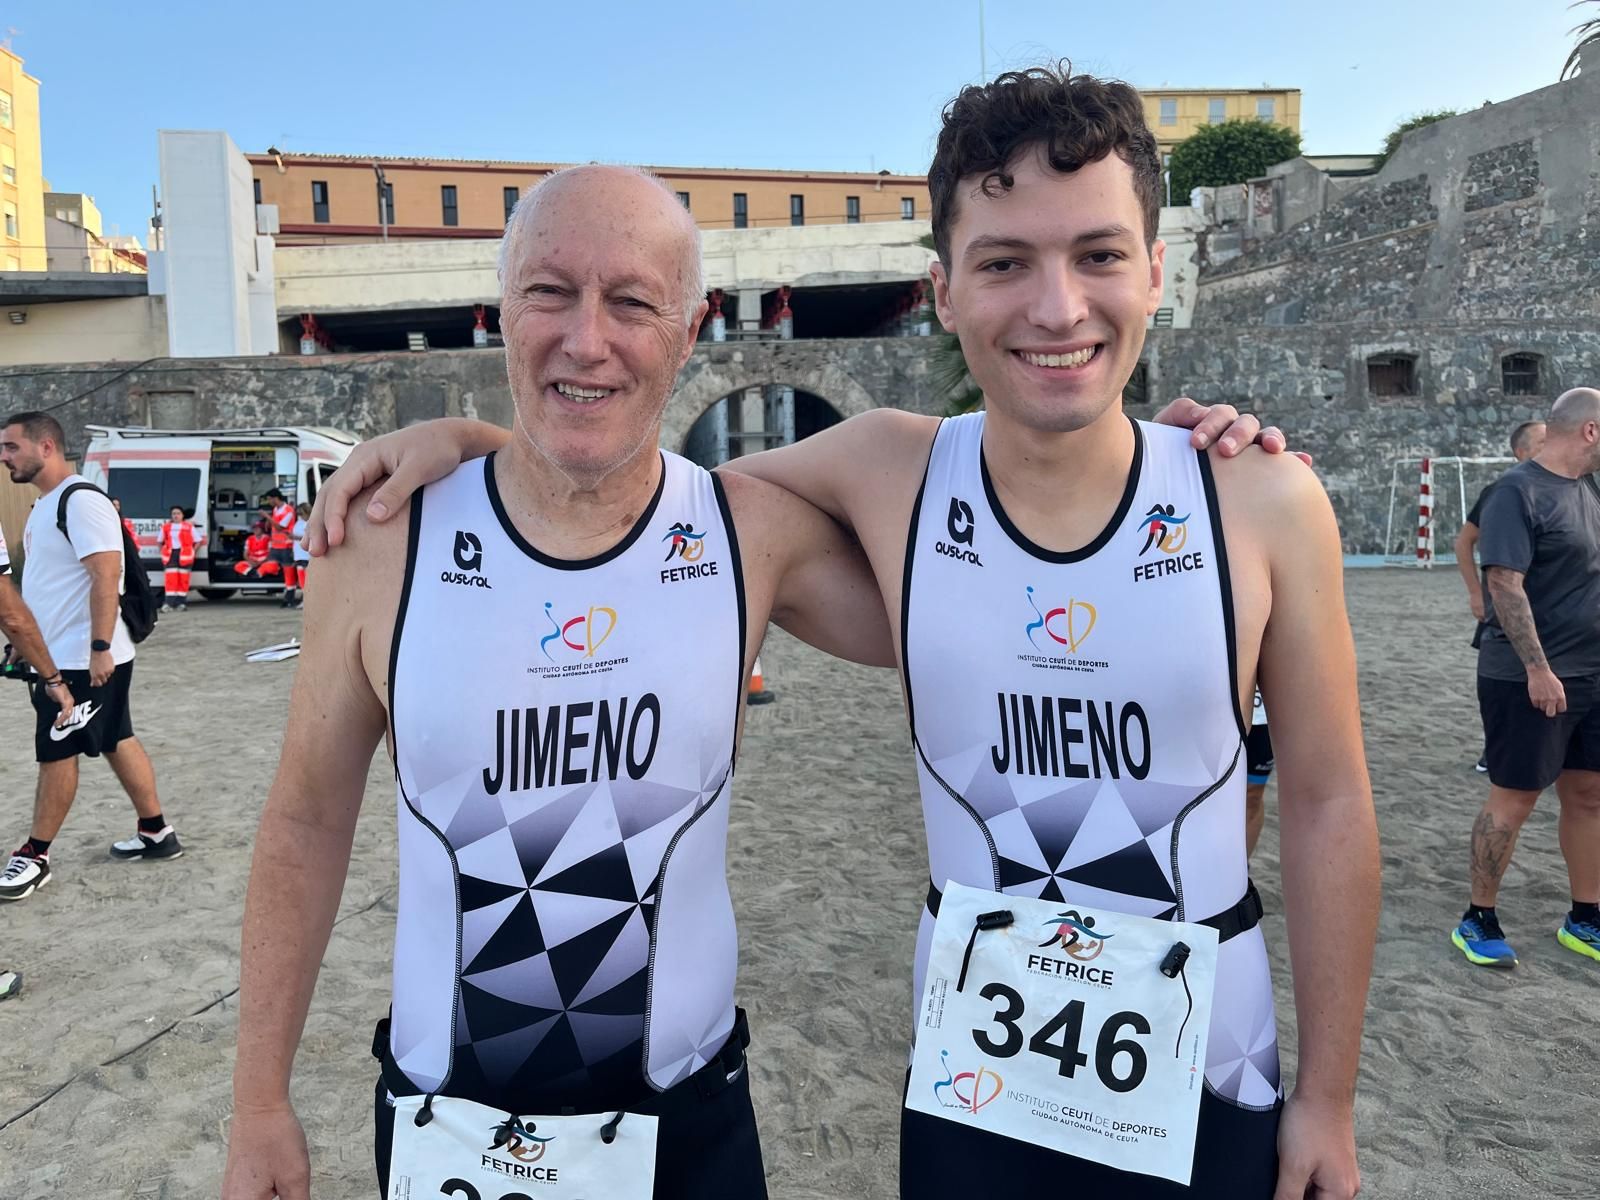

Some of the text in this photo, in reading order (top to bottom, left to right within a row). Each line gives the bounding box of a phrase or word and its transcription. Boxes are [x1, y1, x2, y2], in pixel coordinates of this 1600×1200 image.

[660, 561, 719, 583] FETRICE
[1133, 552, 1204, 582] FETRICE
[527, 666, 561, 674] INSTITUTO
[584, 662, 594, 670] DE
[595, 657, 629, 668] DEPORTES
[1017, 655, 1047, 663] INSTITUTO
[1078, 660, 1109, 668] DEPORTES
[482, 692, 661, 796] JIMENO
[991, 692, 1152, 781] JIMENO
[1027, 954, 1114, 986] FETRICE
[972, 982, 1152, 1093] 346
[1007, 1089, 1168, 1138] INSTITUTO CEUTÍ DE DEPORTES
[1031, 1109, 1059, 1122] CIUDAD
[1104, 1131, 1114, 1139] DE
[1116, 1135, 1139, 1143] CEUTA
[481, 1153, 558, 1182] FETRICE
